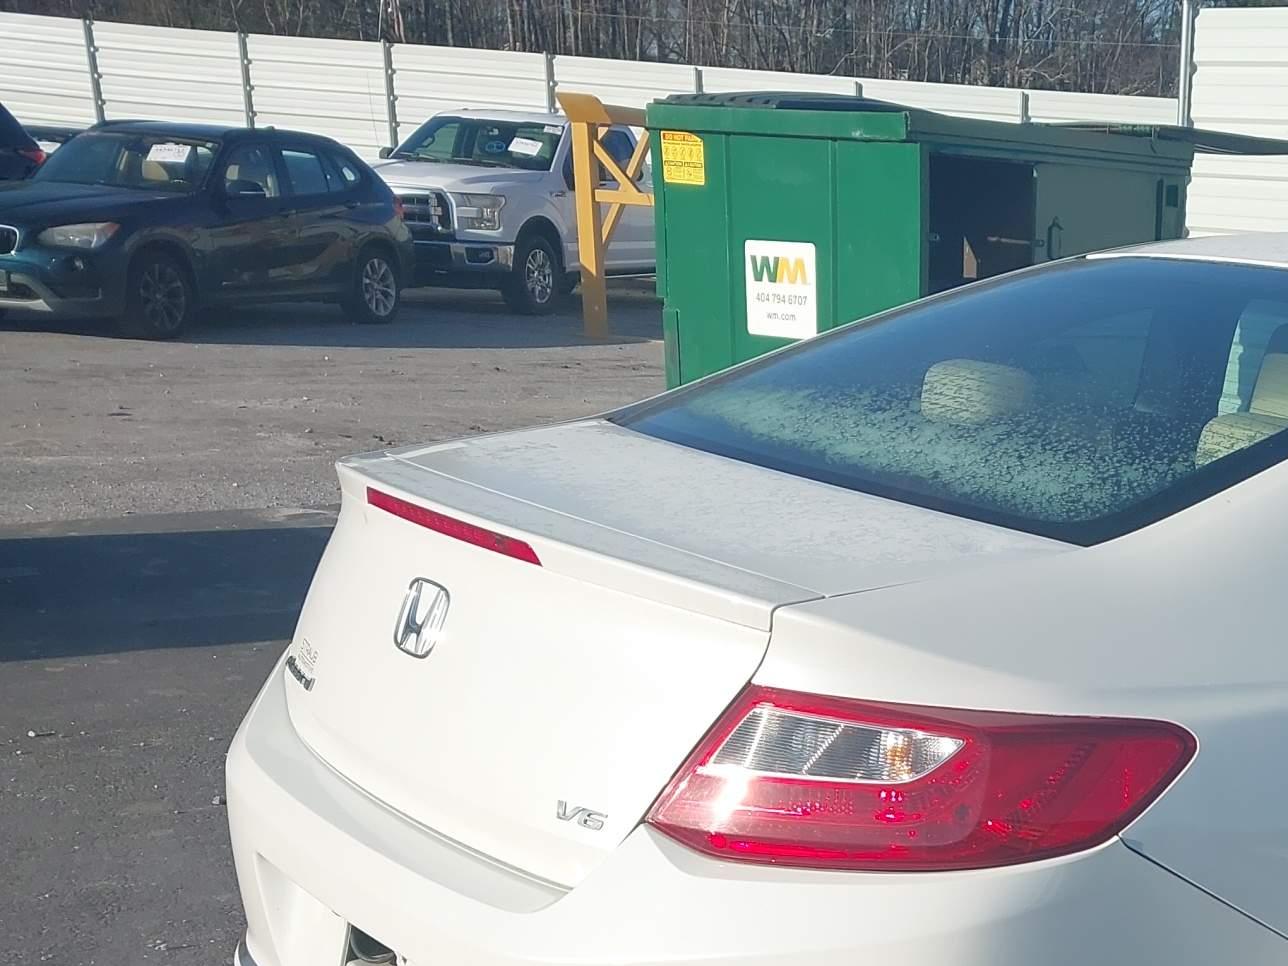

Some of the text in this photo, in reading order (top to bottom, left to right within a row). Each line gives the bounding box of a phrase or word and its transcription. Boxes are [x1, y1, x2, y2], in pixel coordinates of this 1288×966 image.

[750, 255, 808, 285] WM
[756, 292, 770, 303] 404
[771, 293, 786, 304] 794
[767, 312, 796, 321] wm.com
[557, 800, 608, 830] V6
